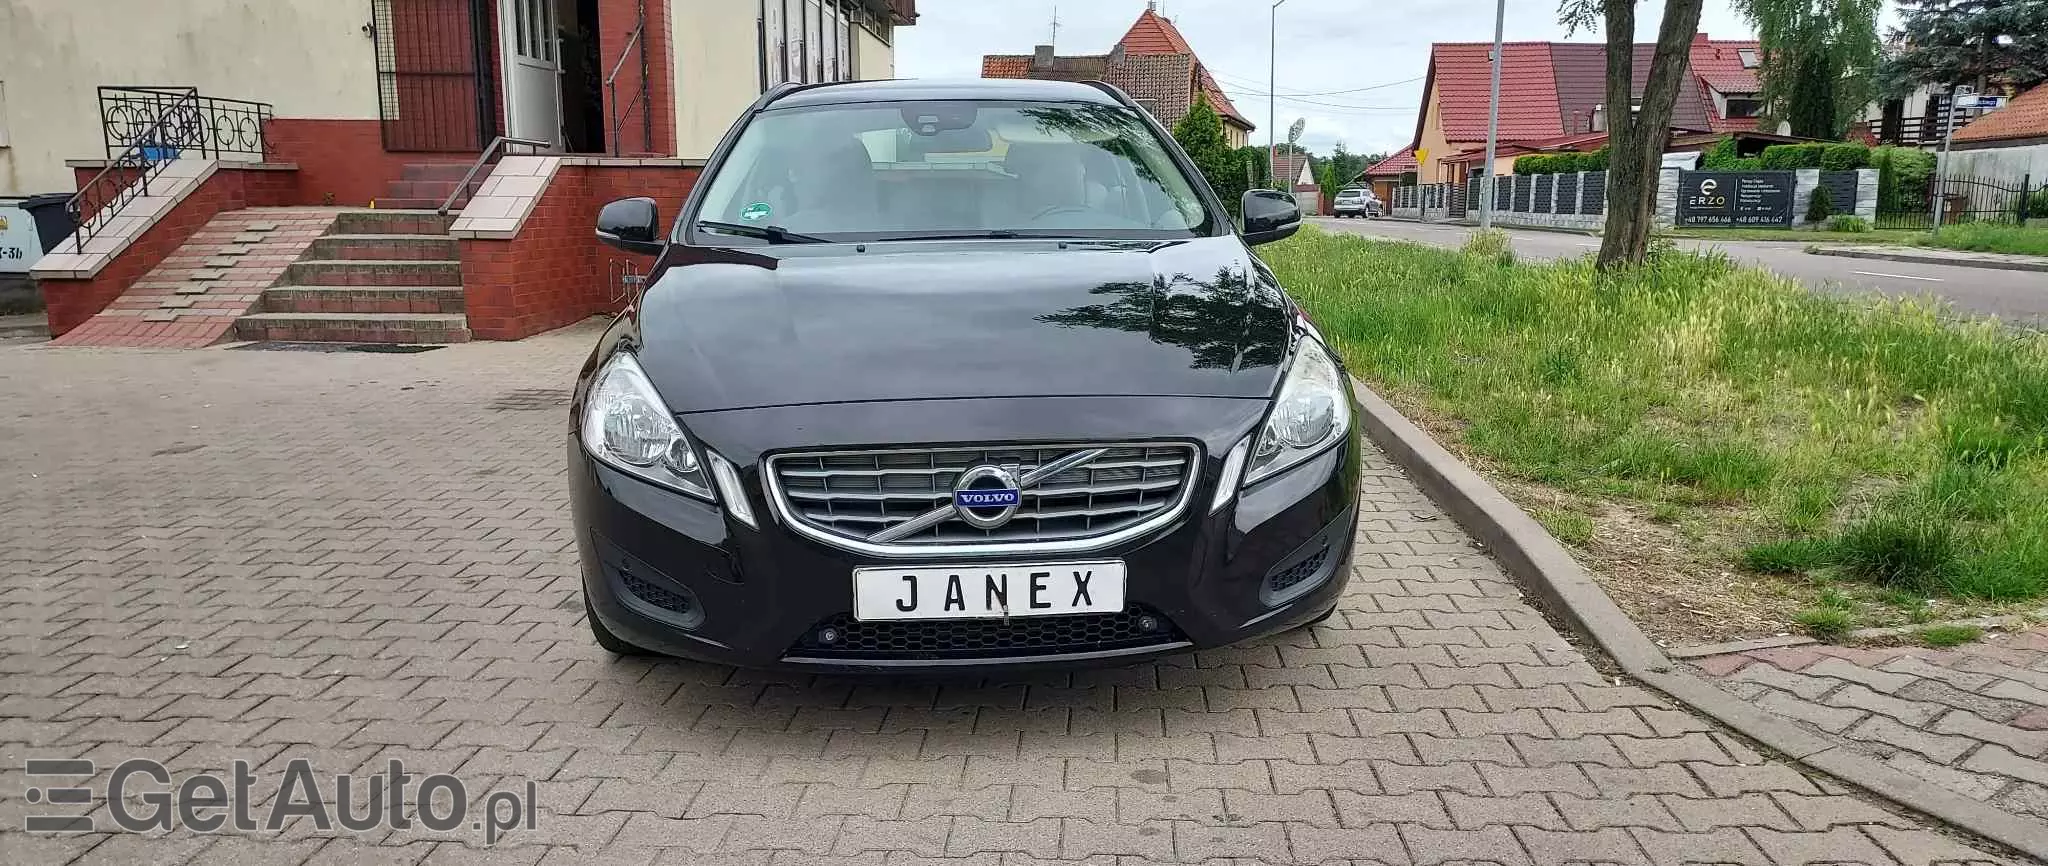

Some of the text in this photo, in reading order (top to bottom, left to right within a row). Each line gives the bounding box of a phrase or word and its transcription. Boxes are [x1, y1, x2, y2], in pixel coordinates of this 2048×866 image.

[1689, 196, 1725, 205] ERZO
[960, 493, 1015, 503] VOLVO
[895, 570, 1093, 612] JANEX
